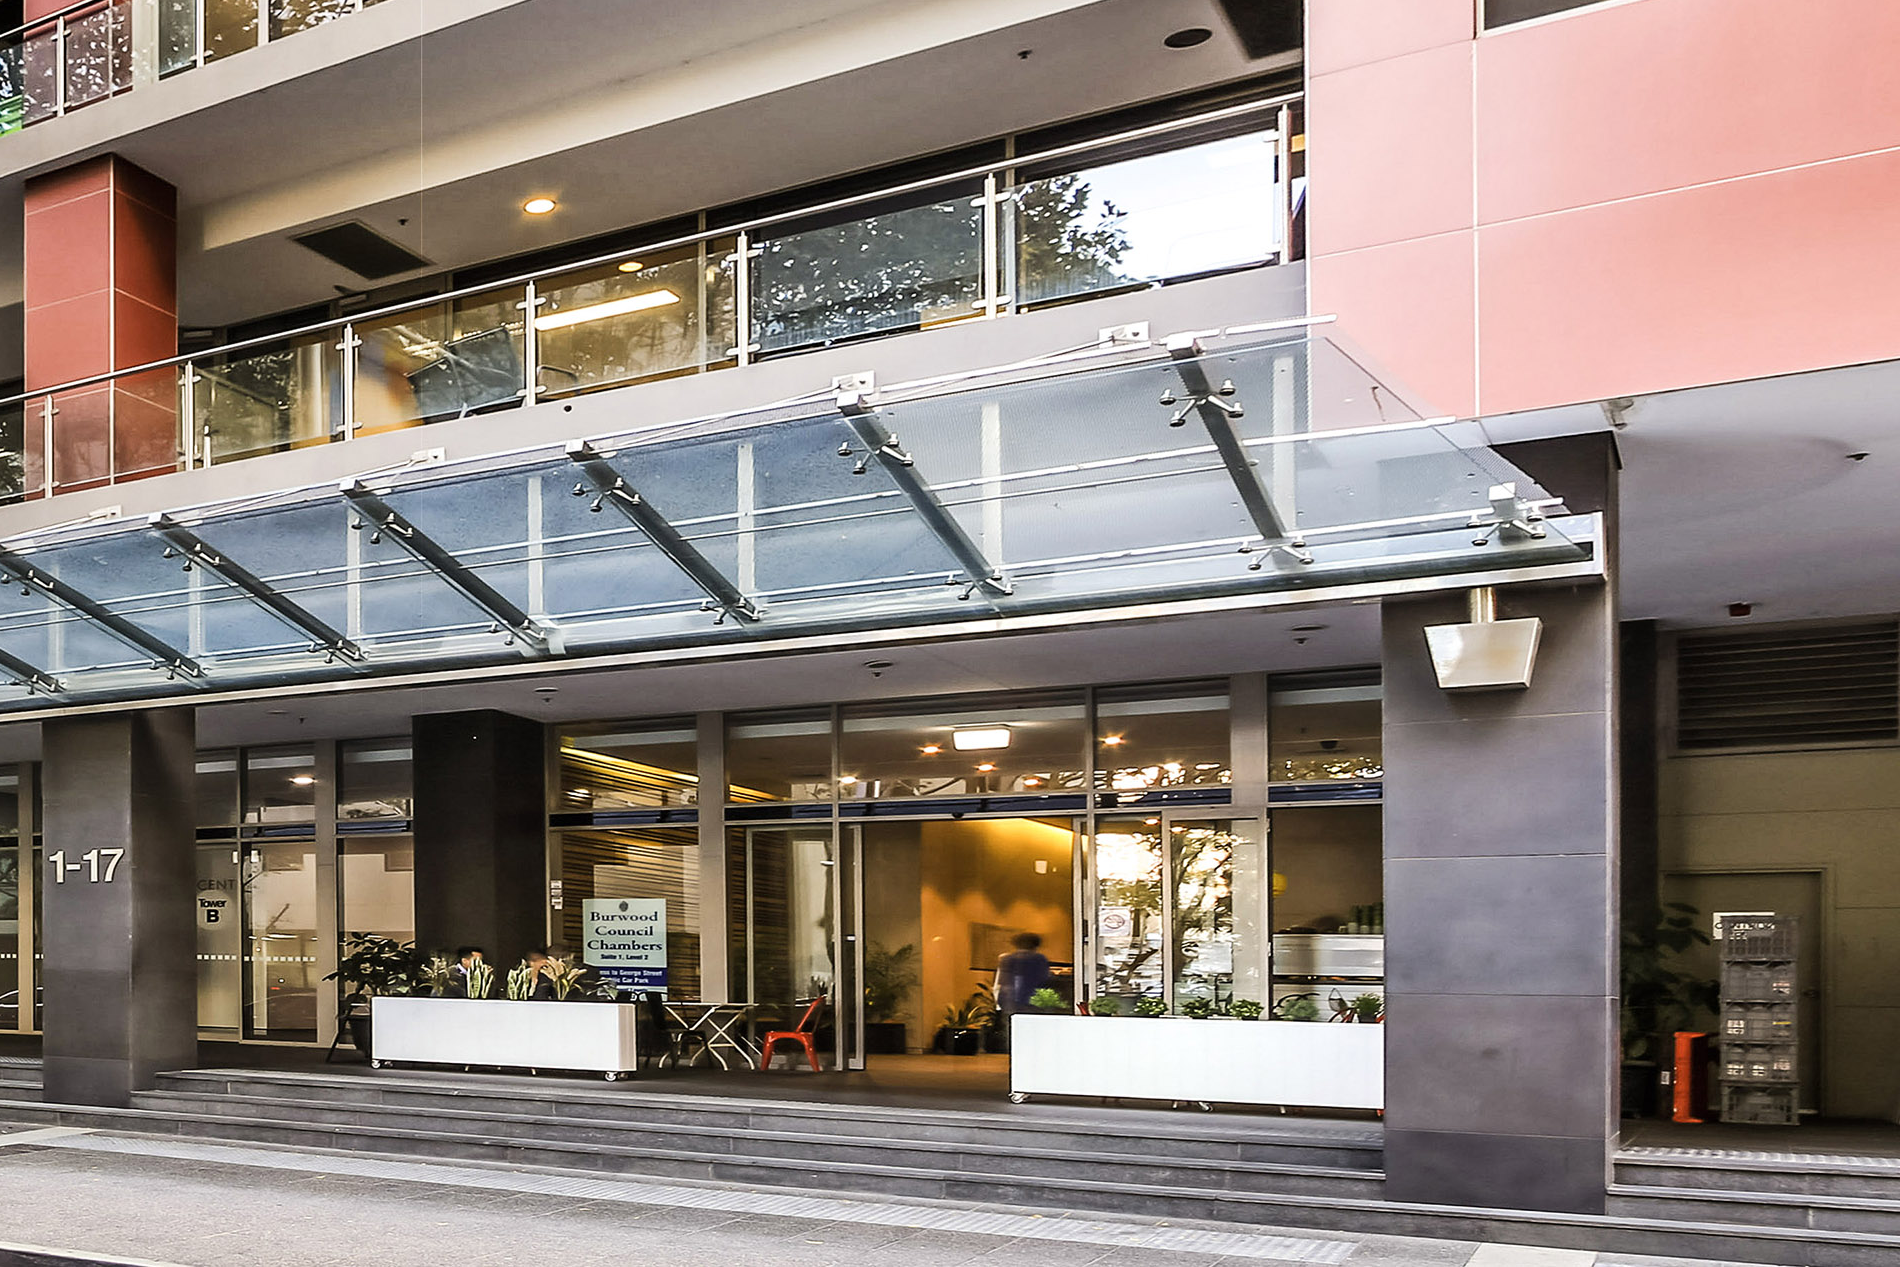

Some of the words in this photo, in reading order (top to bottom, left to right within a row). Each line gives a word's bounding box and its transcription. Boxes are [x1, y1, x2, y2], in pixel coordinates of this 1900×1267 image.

[48, 847, 125, 884] 1-17
[198, 898, 227, 908] Tower
[206, 909, 220, 923] B
[590, 911, 658, 922] Burwood
[595, 925, 653, 936] Council
[587, 939, 663, 951] Chambers
